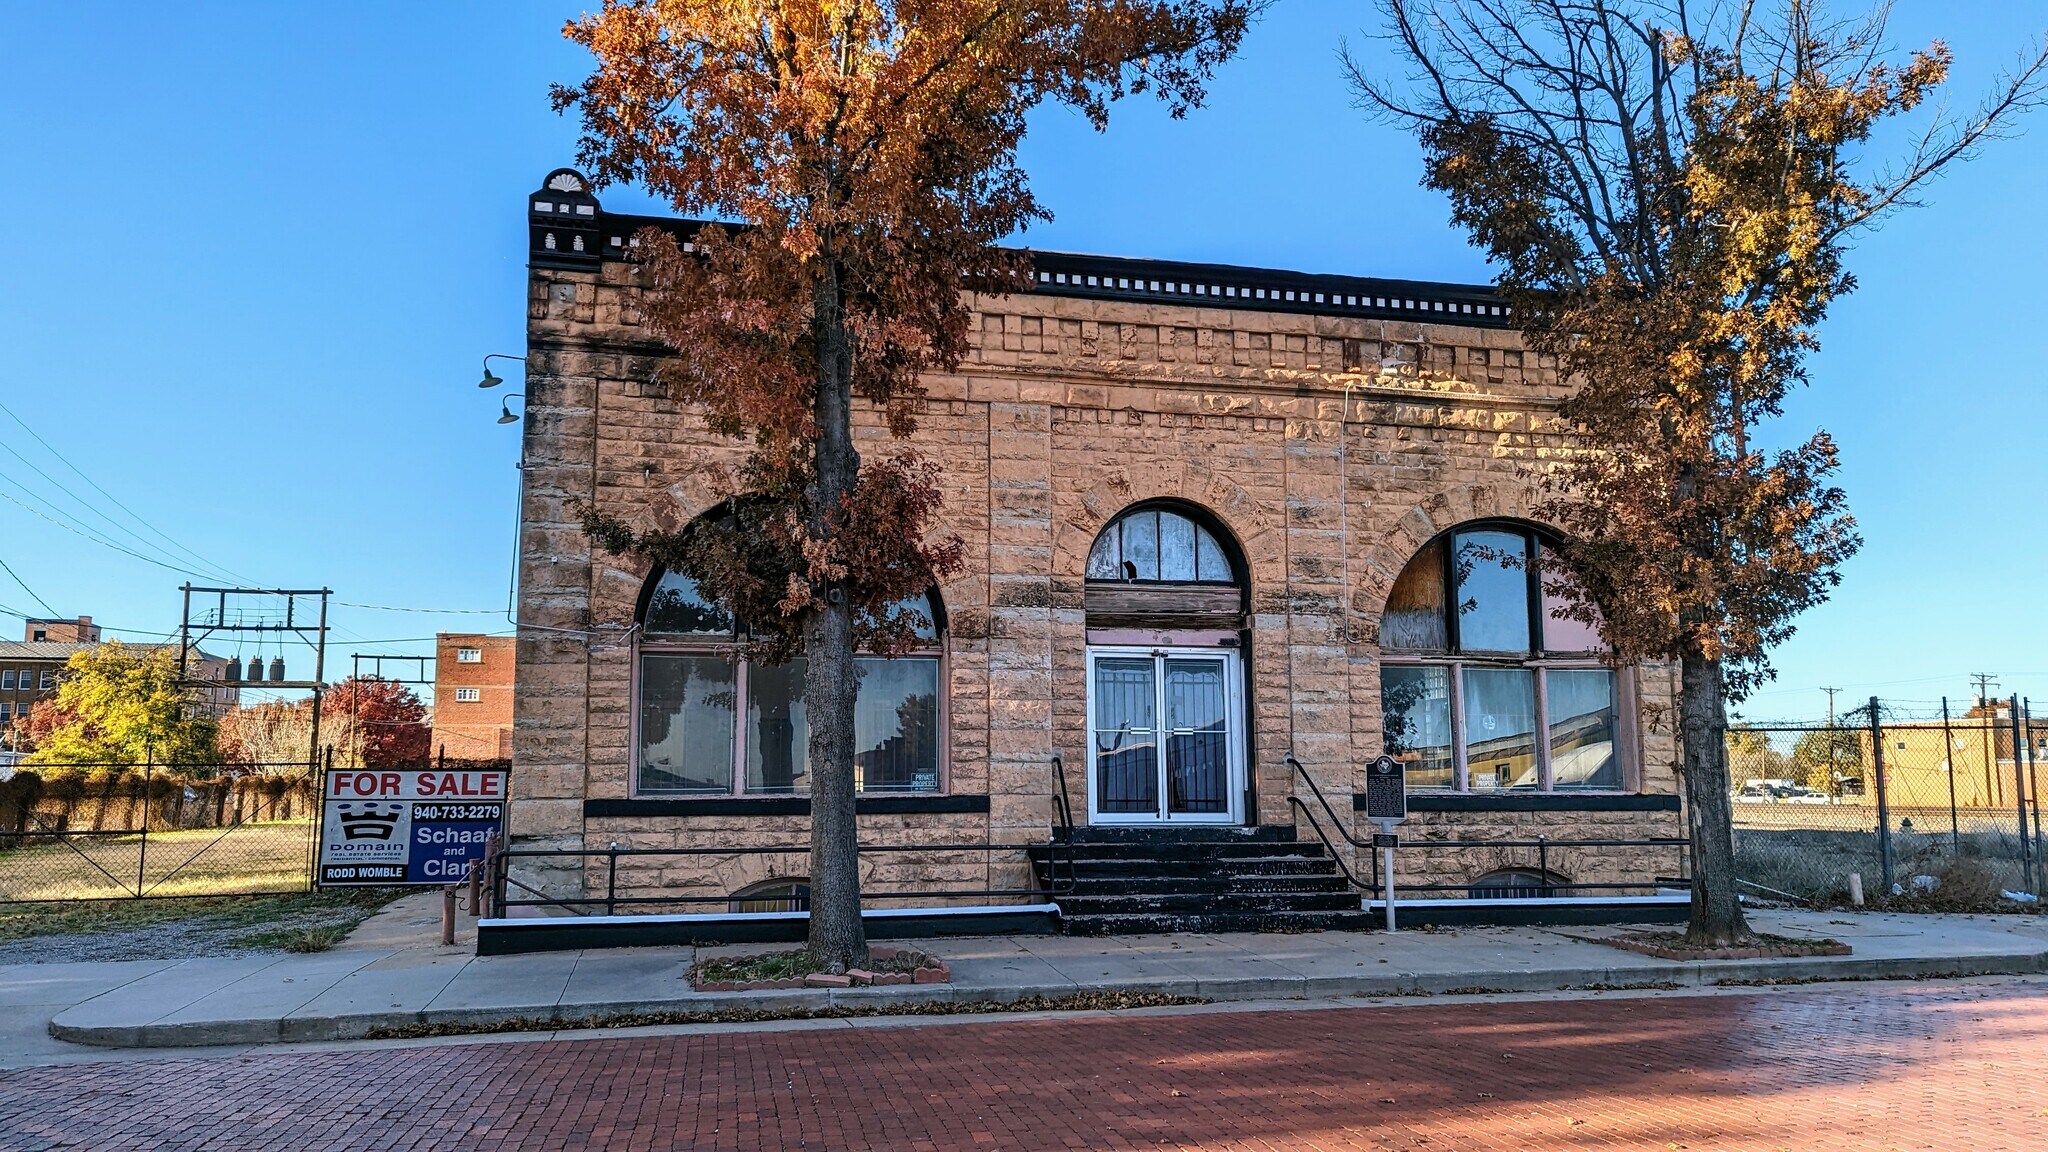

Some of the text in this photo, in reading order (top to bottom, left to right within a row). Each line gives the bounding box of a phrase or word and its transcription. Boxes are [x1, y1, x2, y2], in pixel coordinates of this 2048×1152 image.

[333, 773, 499, 795] FOR SALE
[414, 806, 500, 819] 940-733-2279
[443, 846, 466, 856] and
[327, 867, 403, 879] RODD WOMBLE
[423, 859, 482, 876] Clar
